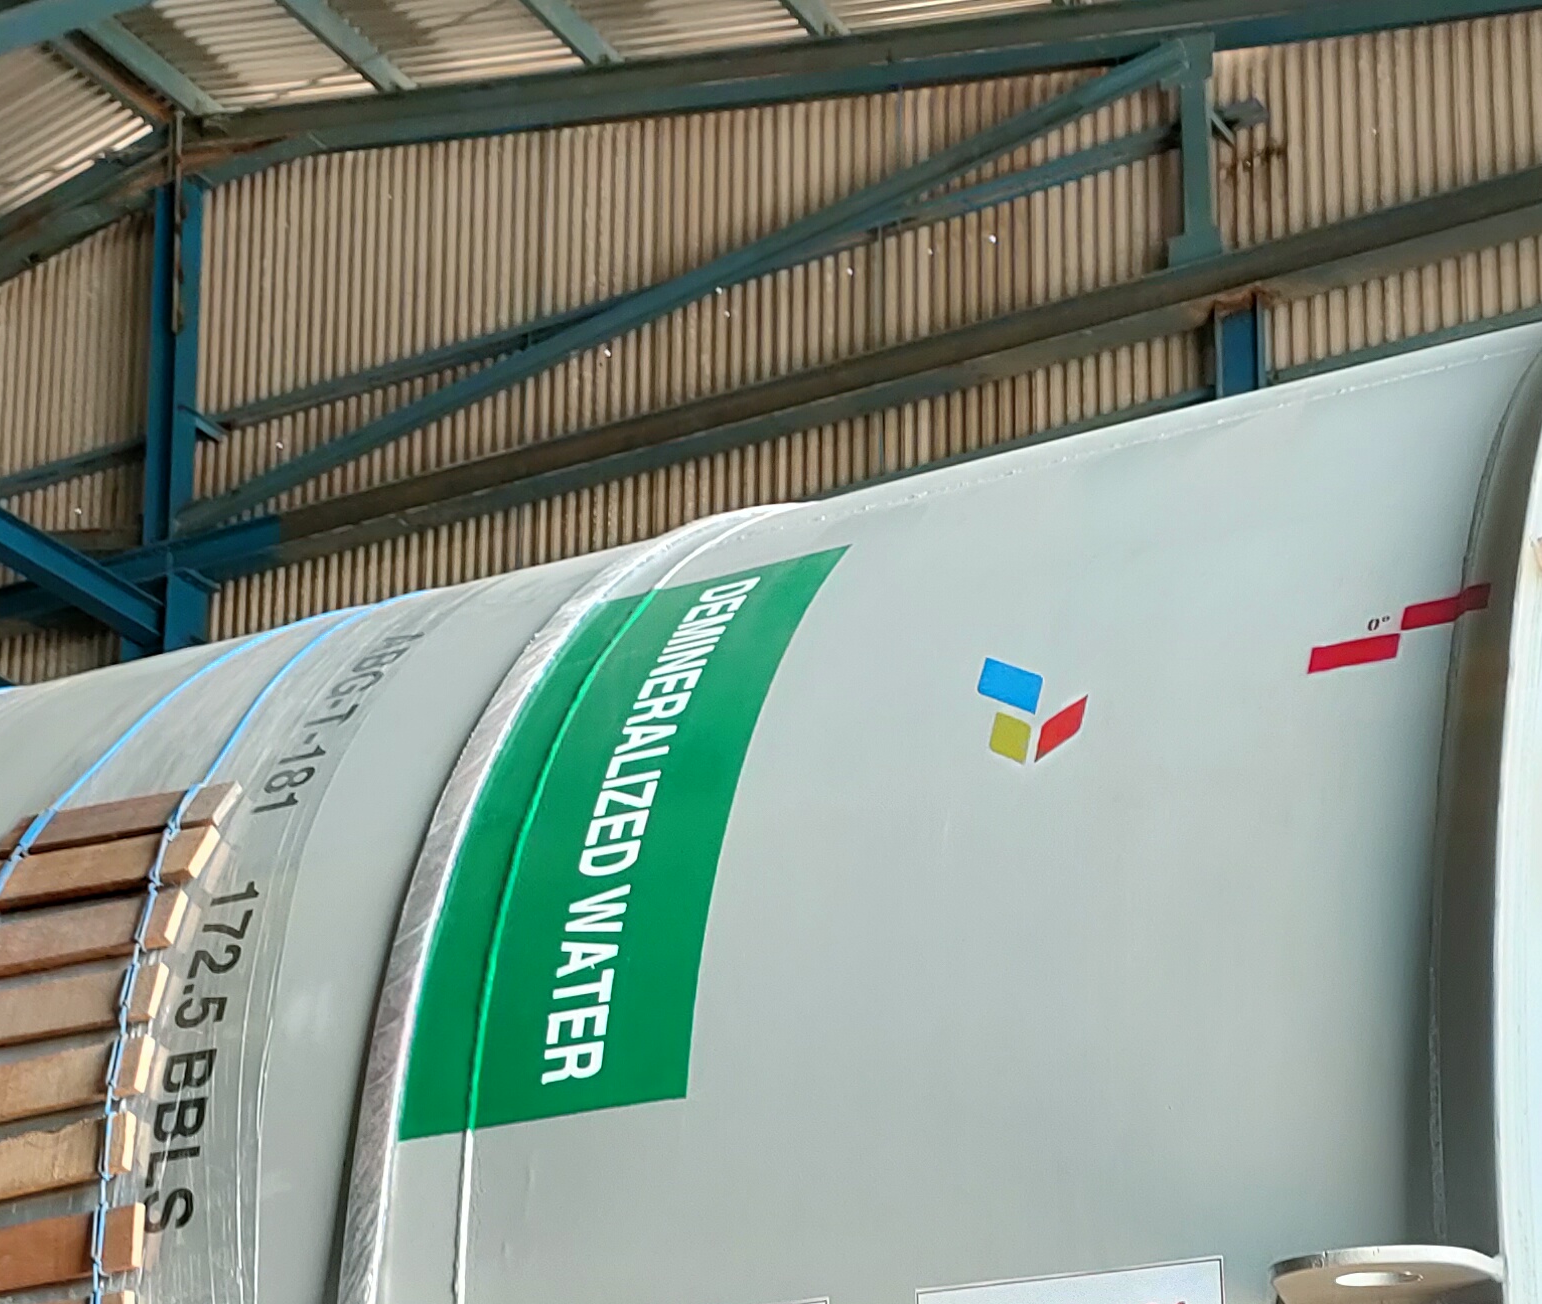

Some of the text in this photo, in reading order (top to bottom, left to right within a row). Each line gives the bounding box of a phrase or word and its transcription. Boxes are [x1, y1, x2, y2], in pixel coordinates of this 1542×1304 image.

[252, 631, 425, 814] ABG-T-181
[541, 575, 761, 1084] DEMINERALIZED WATER
[144, 880, 260, 1234] 172.5 BBLS
